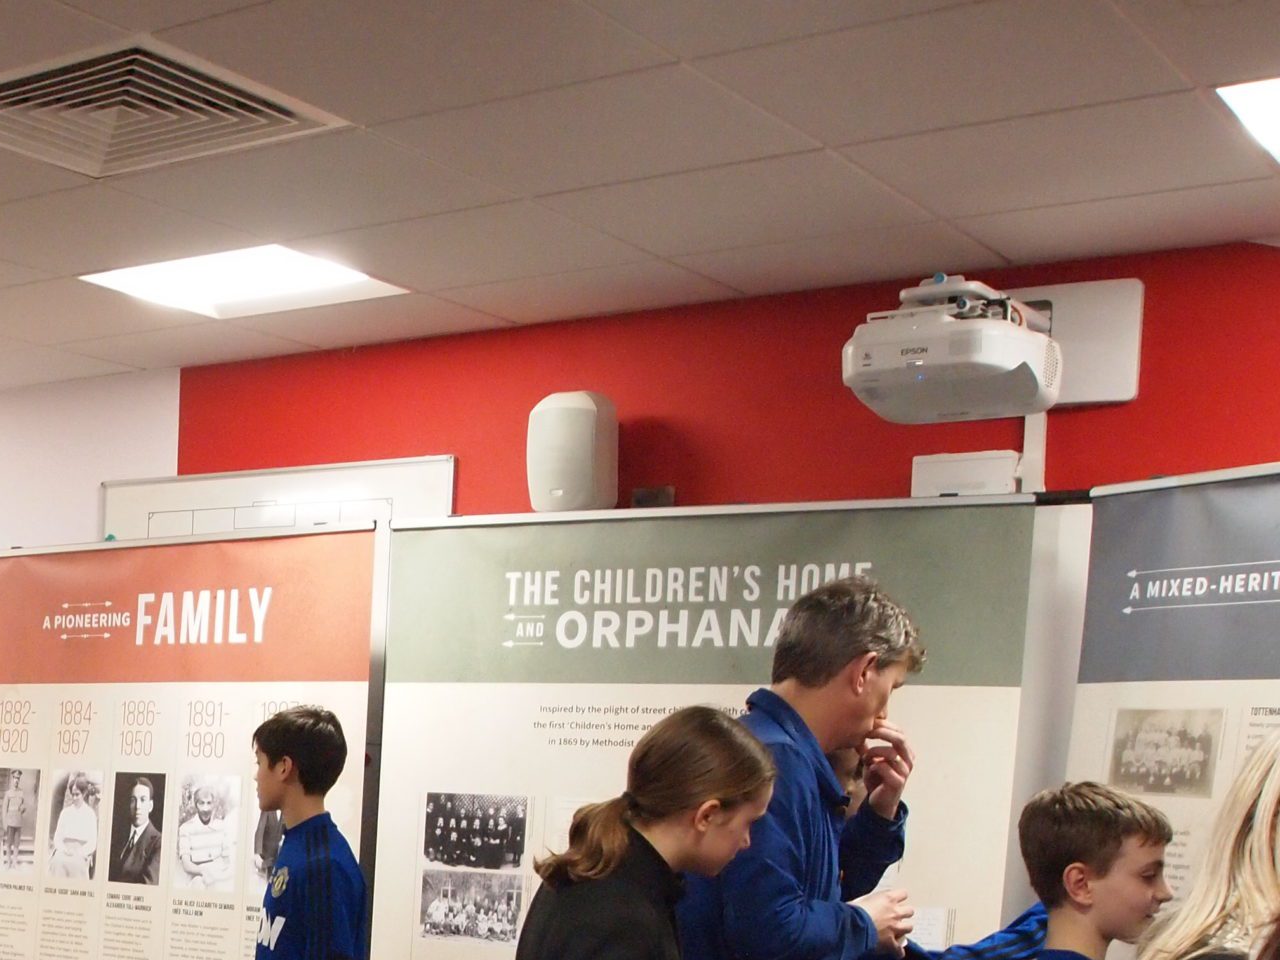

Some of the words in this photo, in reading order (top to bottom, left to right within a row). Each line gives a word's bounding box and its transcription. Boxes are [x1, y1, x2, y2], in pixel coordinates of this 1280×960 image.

[901, 347, 928, 356] EPSON
[505, 571, 559, 606] THE
[574, 565, 761, 605] CHILDREN'S
[1129, 582, 1140, 600] A
[43, 615, 51, 630] A
[54, 612, 131, 629] PIONEERING
[135, 587, 273, 645] FAMILY
[516, 622, 545, 638] AND
[540, 705, 574, 715] Inspired
[576, 706, 586, 716] by
[588, 706, 601, 714] the
[603, 706, 628, 717] plight
[631, 706, 639, 714] of
[534, 720, 547, 729] the
[549, 721, 565, 729] first
[614, 722, 640, 731] Home
[56, 730, 90, 755] 1967
[120, 730, 152, 756] 1950
[185, 731, 225, 759] 1980
[548, 737, 556, 745] in
[558, 737, 578, 746] 1869
[579, 738, 590, 748] by
[592, 738, 634, 747] Methodist
